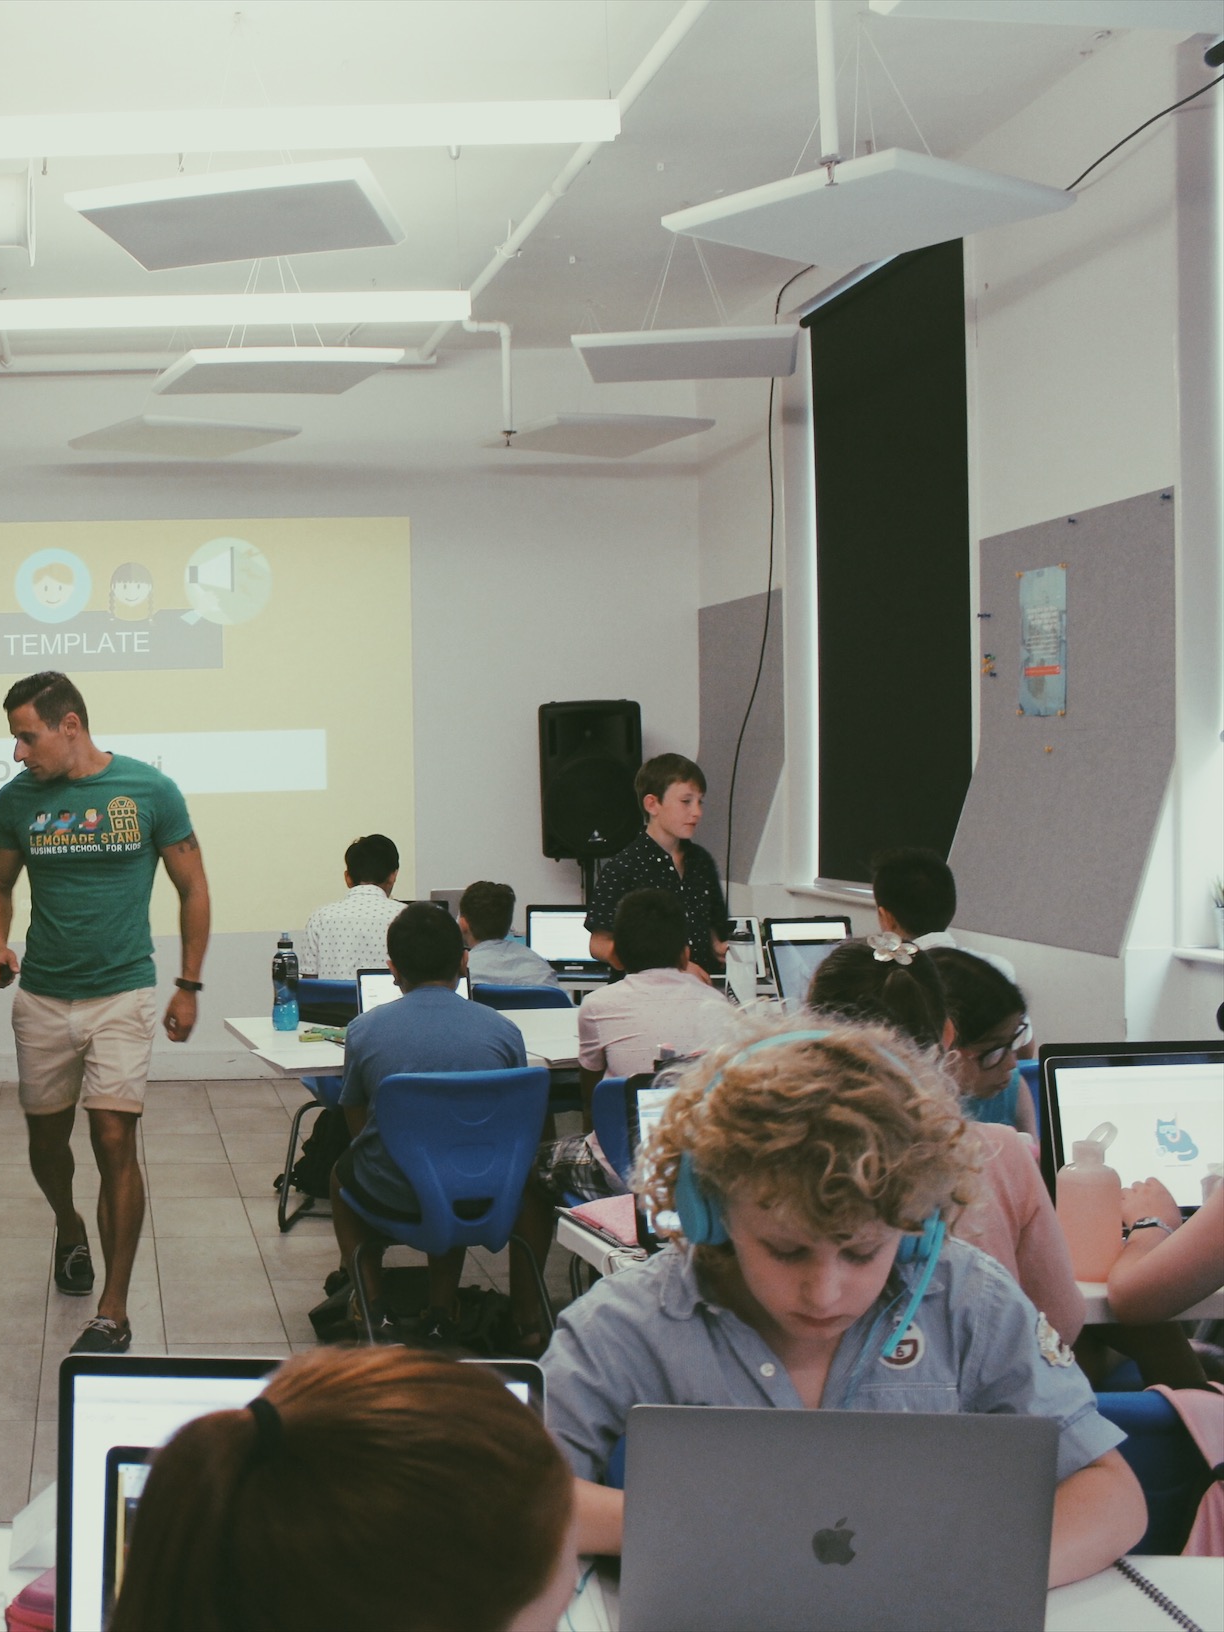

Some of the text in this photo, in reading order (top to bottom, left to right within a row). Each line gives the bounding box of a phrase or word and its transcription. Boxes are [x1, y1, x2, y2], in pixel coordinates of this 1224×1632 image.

[4, 631, 150, 656] TEMPLATE
[29, 831, 141, 847] LEMONADE STAND
[30, 842, 142, 855] BUSINESS SCHOOL FOR KIDS
